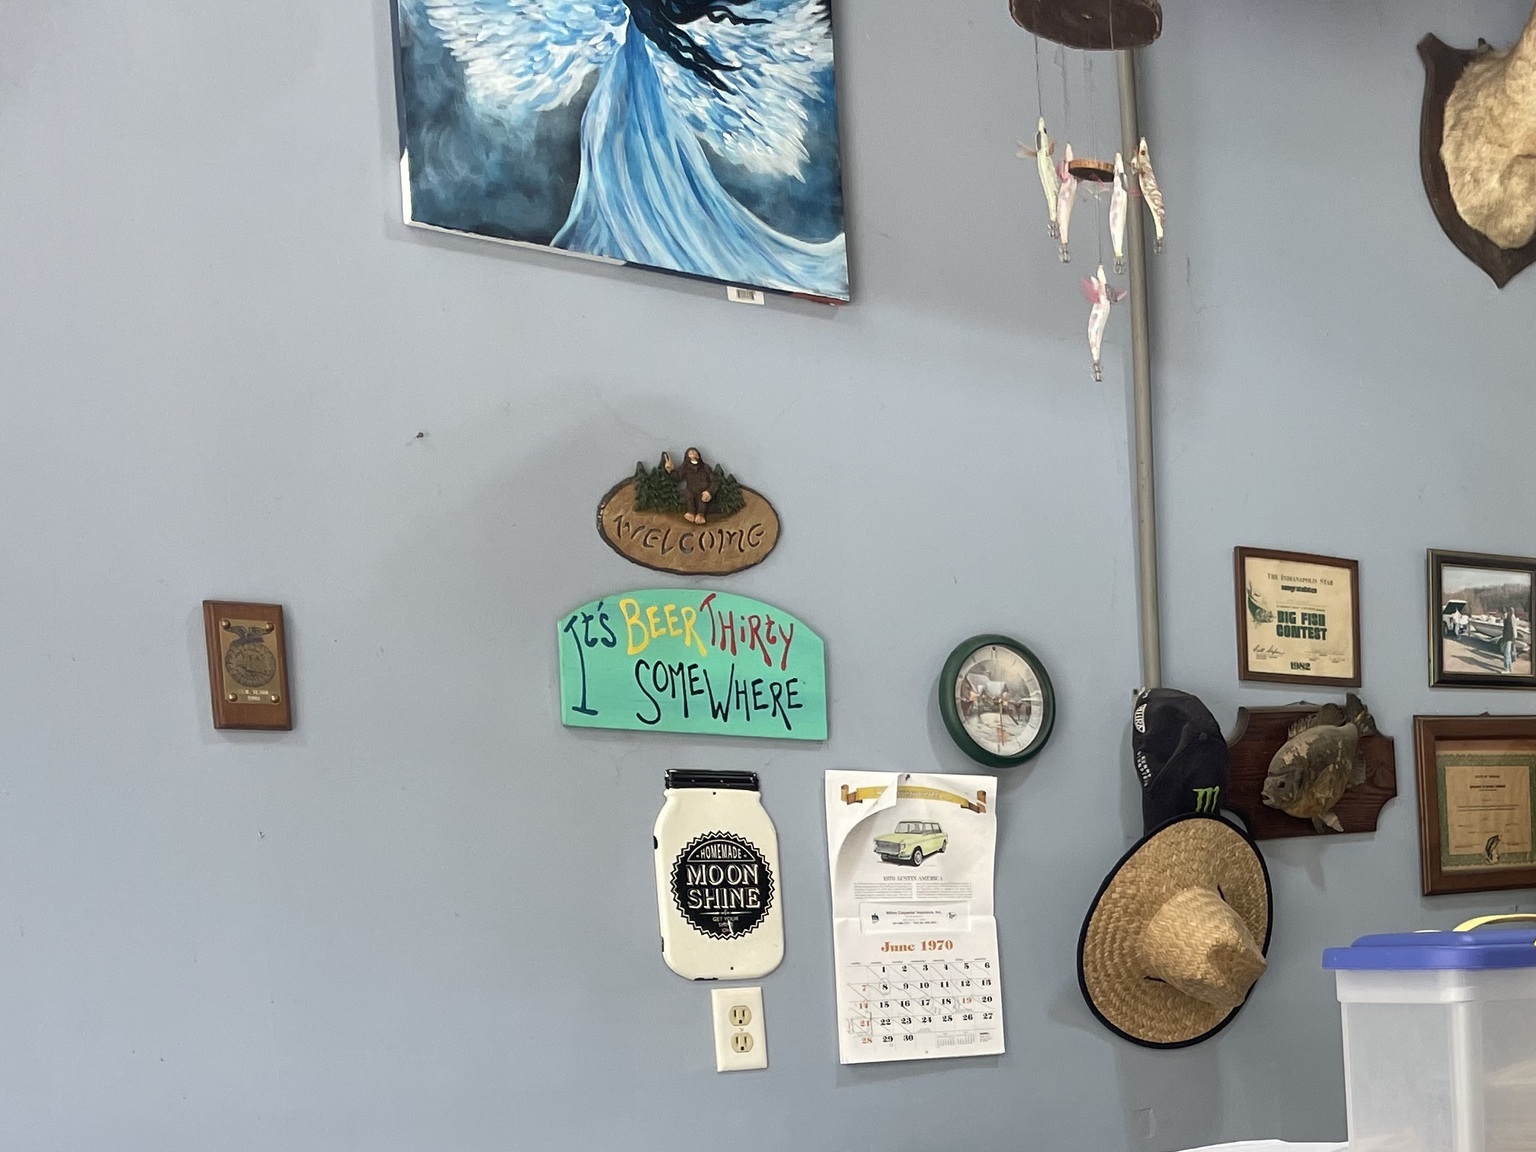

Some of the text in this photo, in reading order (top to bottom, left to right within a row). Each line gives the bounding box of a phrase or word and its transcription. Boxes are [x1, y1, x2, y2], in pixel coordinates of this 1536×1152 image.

[1277, 611, 1325, 626] BIG FISH
[619, 598, 707, 656] BEER
[1276, 625, 1327, 640] CONTEST
[701, 844, 741, 859] HOMEMADE
[686, 865, 758, 885] MOON
[687, 888, 760, 908] SHINE
[881, 940, 953, 952] June 1970
